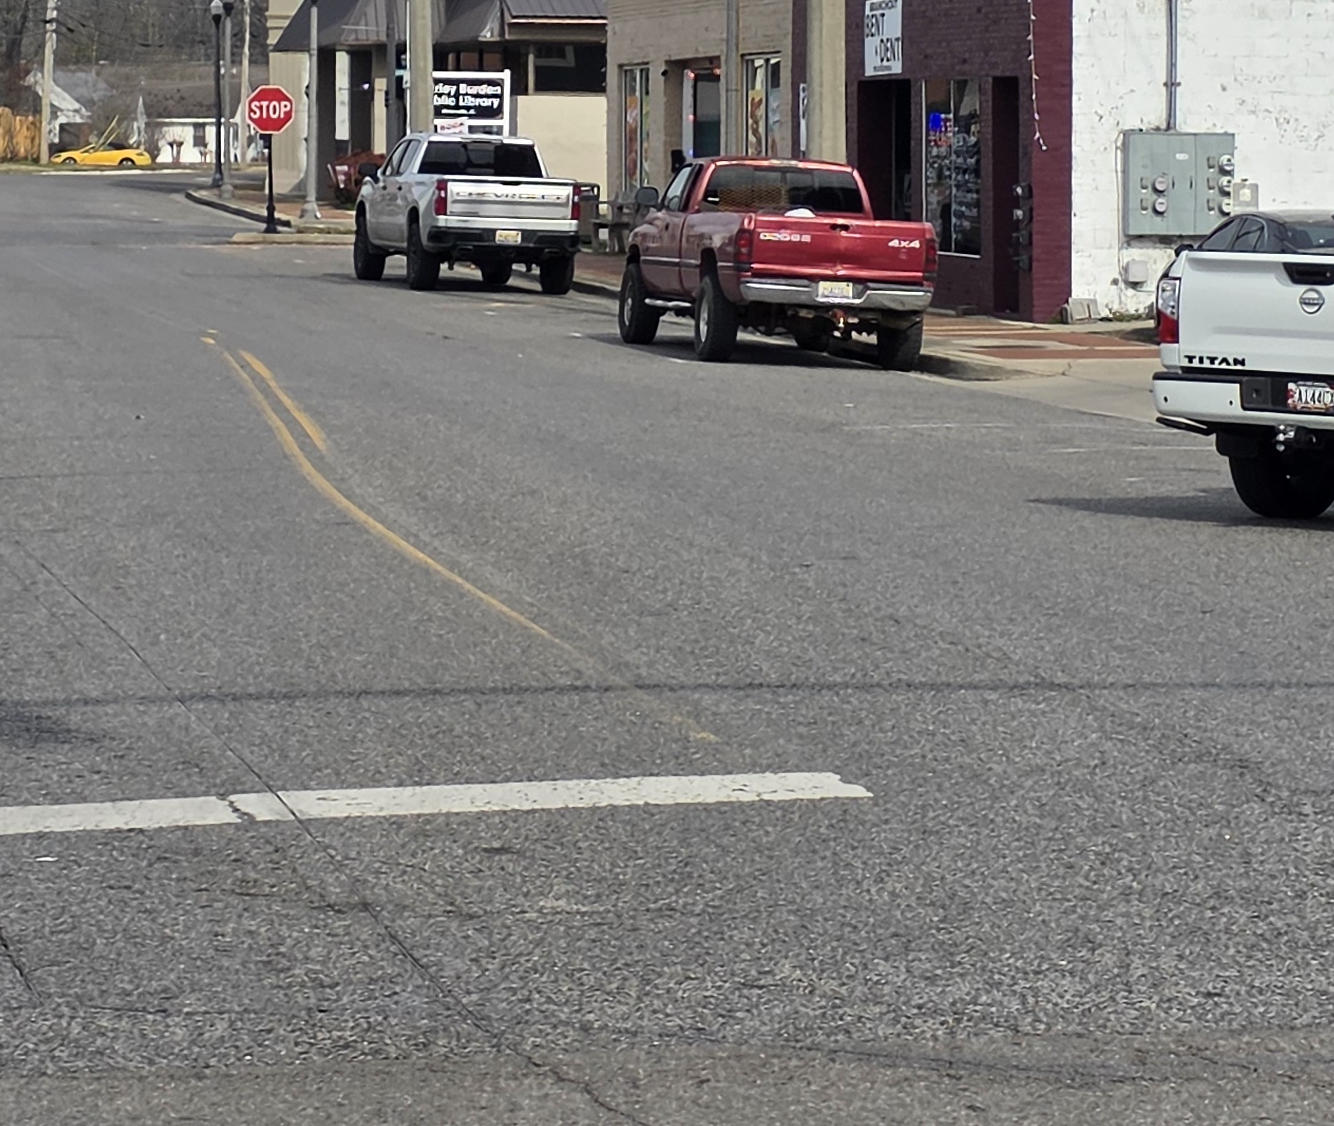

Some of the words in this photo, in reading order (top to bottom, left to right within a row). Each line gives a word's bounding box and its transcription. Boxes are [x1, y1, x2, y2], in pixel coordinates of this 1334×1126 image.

[866, 13, 885, 38] BENT
[879, 37, 901, 64] DENT
[250, 101, 291, 119] STOP
[458, 95, 500, 109] Library
[1183, 354, 1246, 367] TITAN
